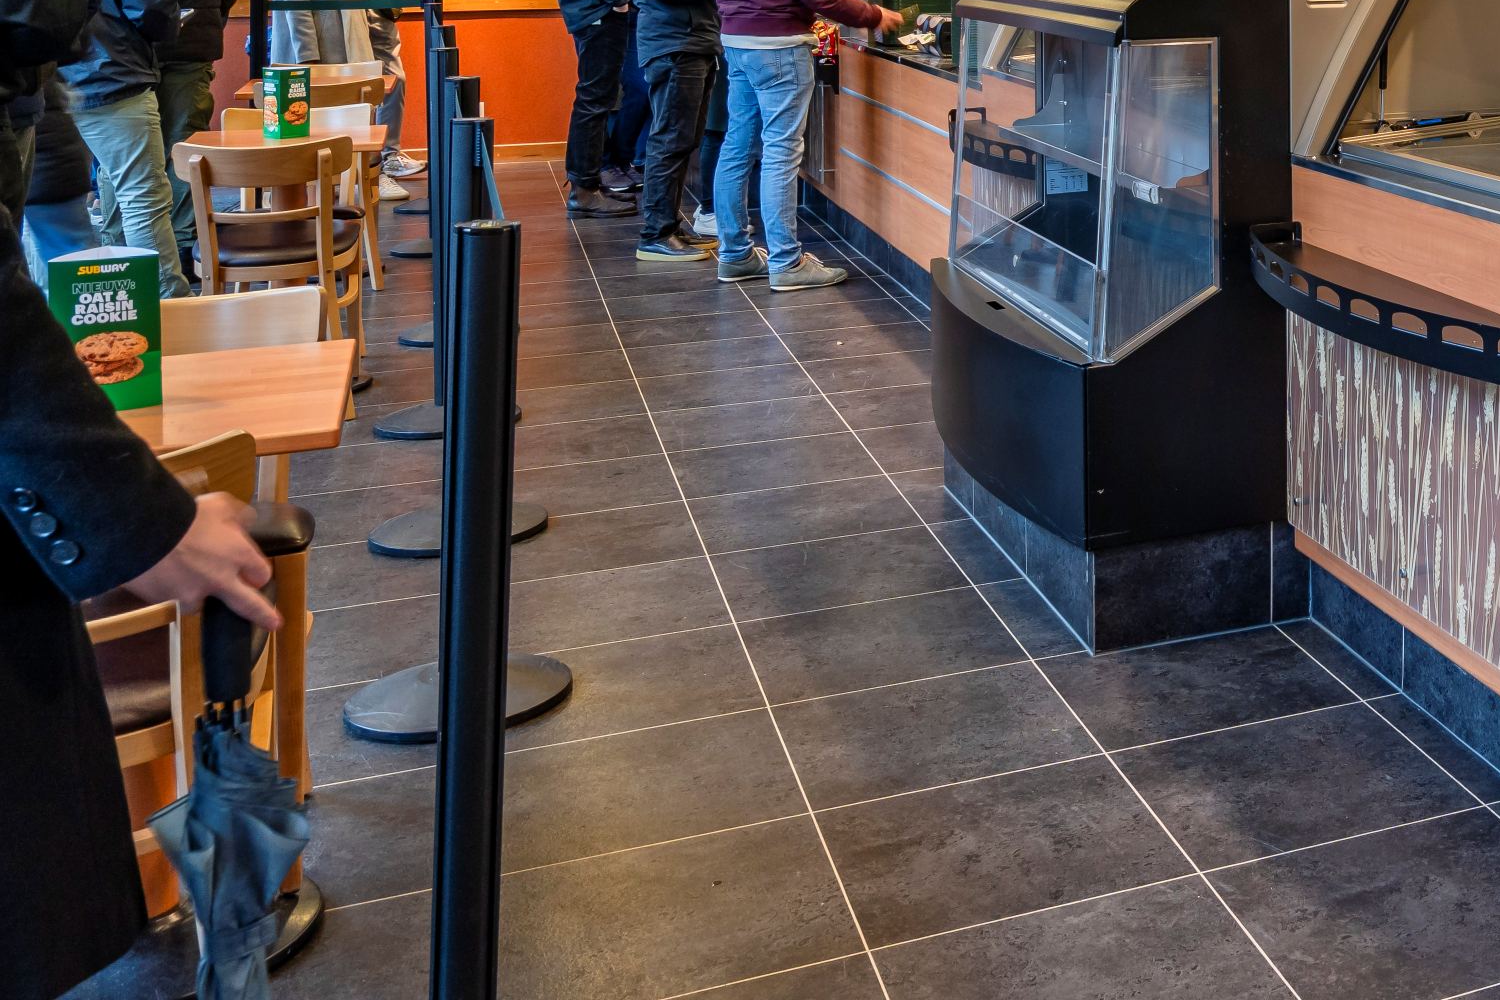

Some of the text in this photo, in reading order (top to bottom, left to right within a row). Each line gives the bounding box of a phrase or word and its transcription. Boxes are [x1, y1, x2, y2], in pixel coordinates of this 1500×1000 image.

[77, 262, 130, 276] SUBWAY
[72, 279, 136, 295] NIEUW:
[79, 290, 129, 304] OAT &
[75, 300, 134, 315] RAISIN
[70, 310, 138, 326] COOKIE
